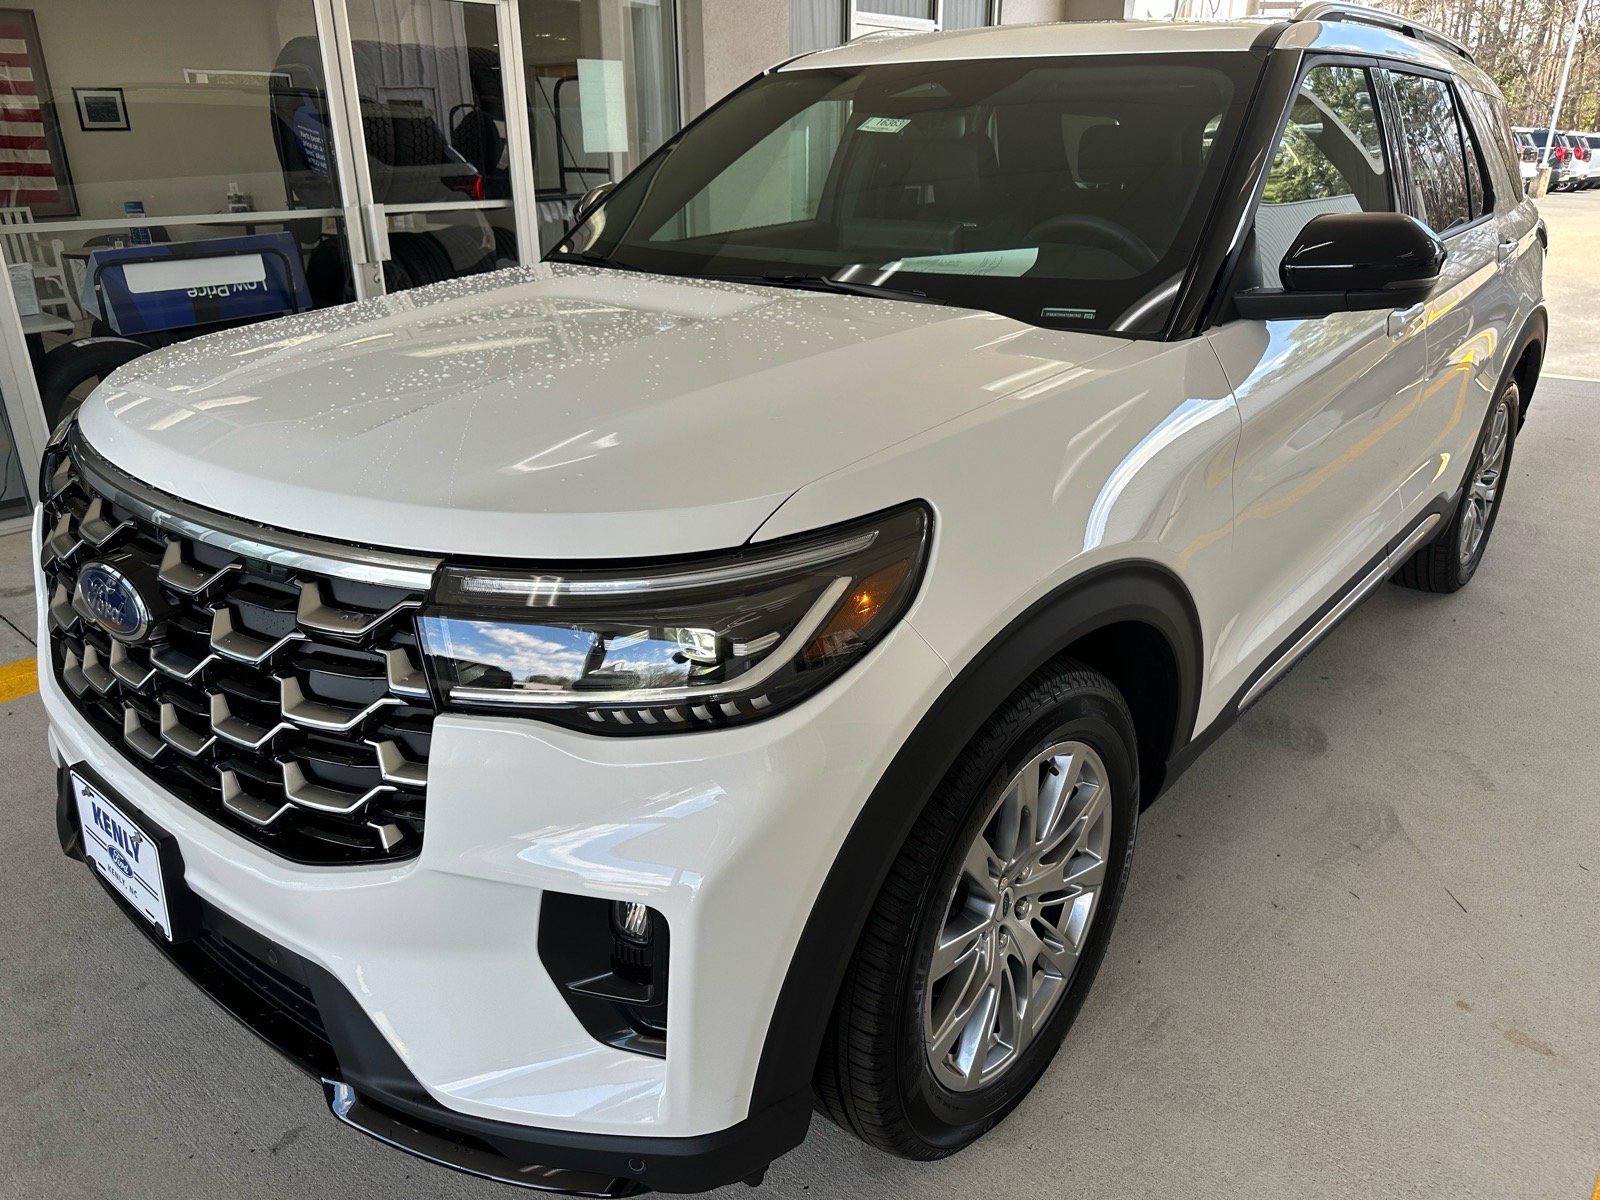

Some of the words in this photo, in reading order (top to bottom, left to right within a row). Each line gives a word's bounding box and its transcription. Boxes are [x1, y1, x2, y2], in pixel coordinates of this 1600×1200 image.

[187, 284, 230, 299] Price
[87, 577, 125, 625] Ford
[91, 801, 140, 864] KENLY
[112, 849, 129, 874] Ford
[129, 886, 138, 899] NC
